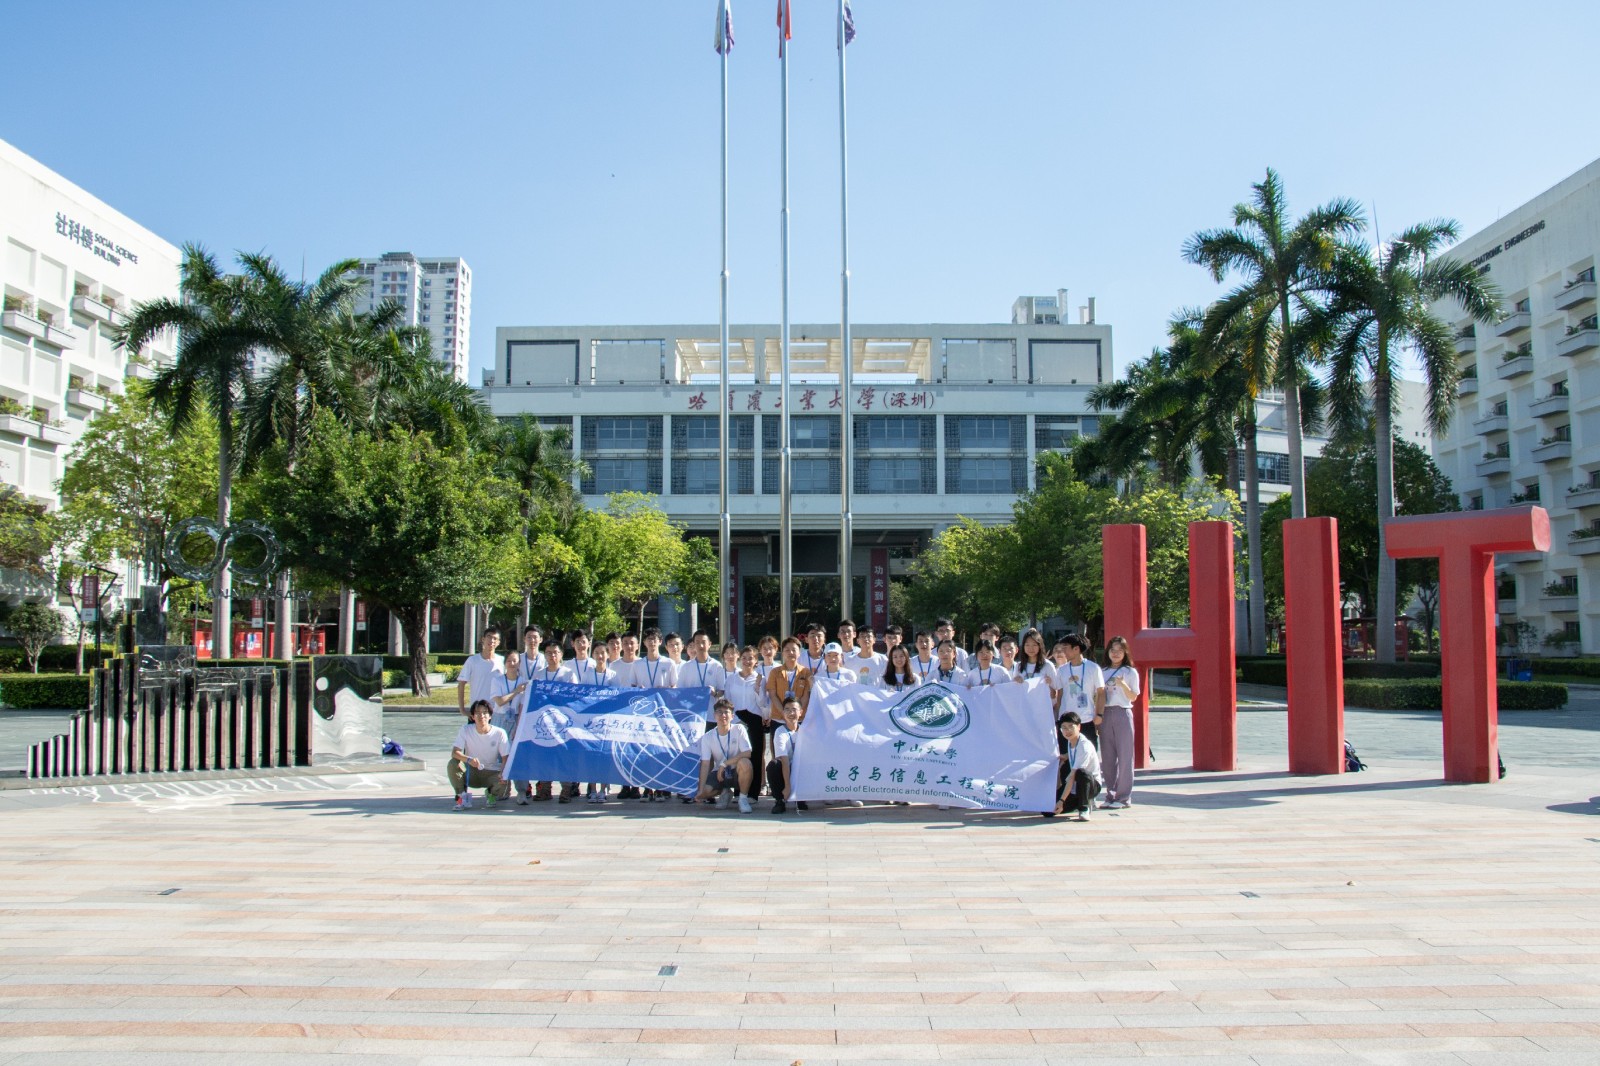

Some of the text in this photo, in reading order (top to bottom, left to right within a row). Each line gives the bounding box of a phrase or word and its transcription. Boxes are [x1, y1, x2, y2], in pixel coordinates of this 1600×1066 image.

[93, 245, 121, 267] BUILDING
[95, 233, 139, 265] SOCIAL SCIENCE
[1471, 219, 1546, 268] CHATRONIC ENGINEERING
[1102, 505, 1551, 784] HIT
[825, 785, 1019, 810] School of Electronic and Information Technology
[826, 765, 1020, 801] 电子与信息工程学院
